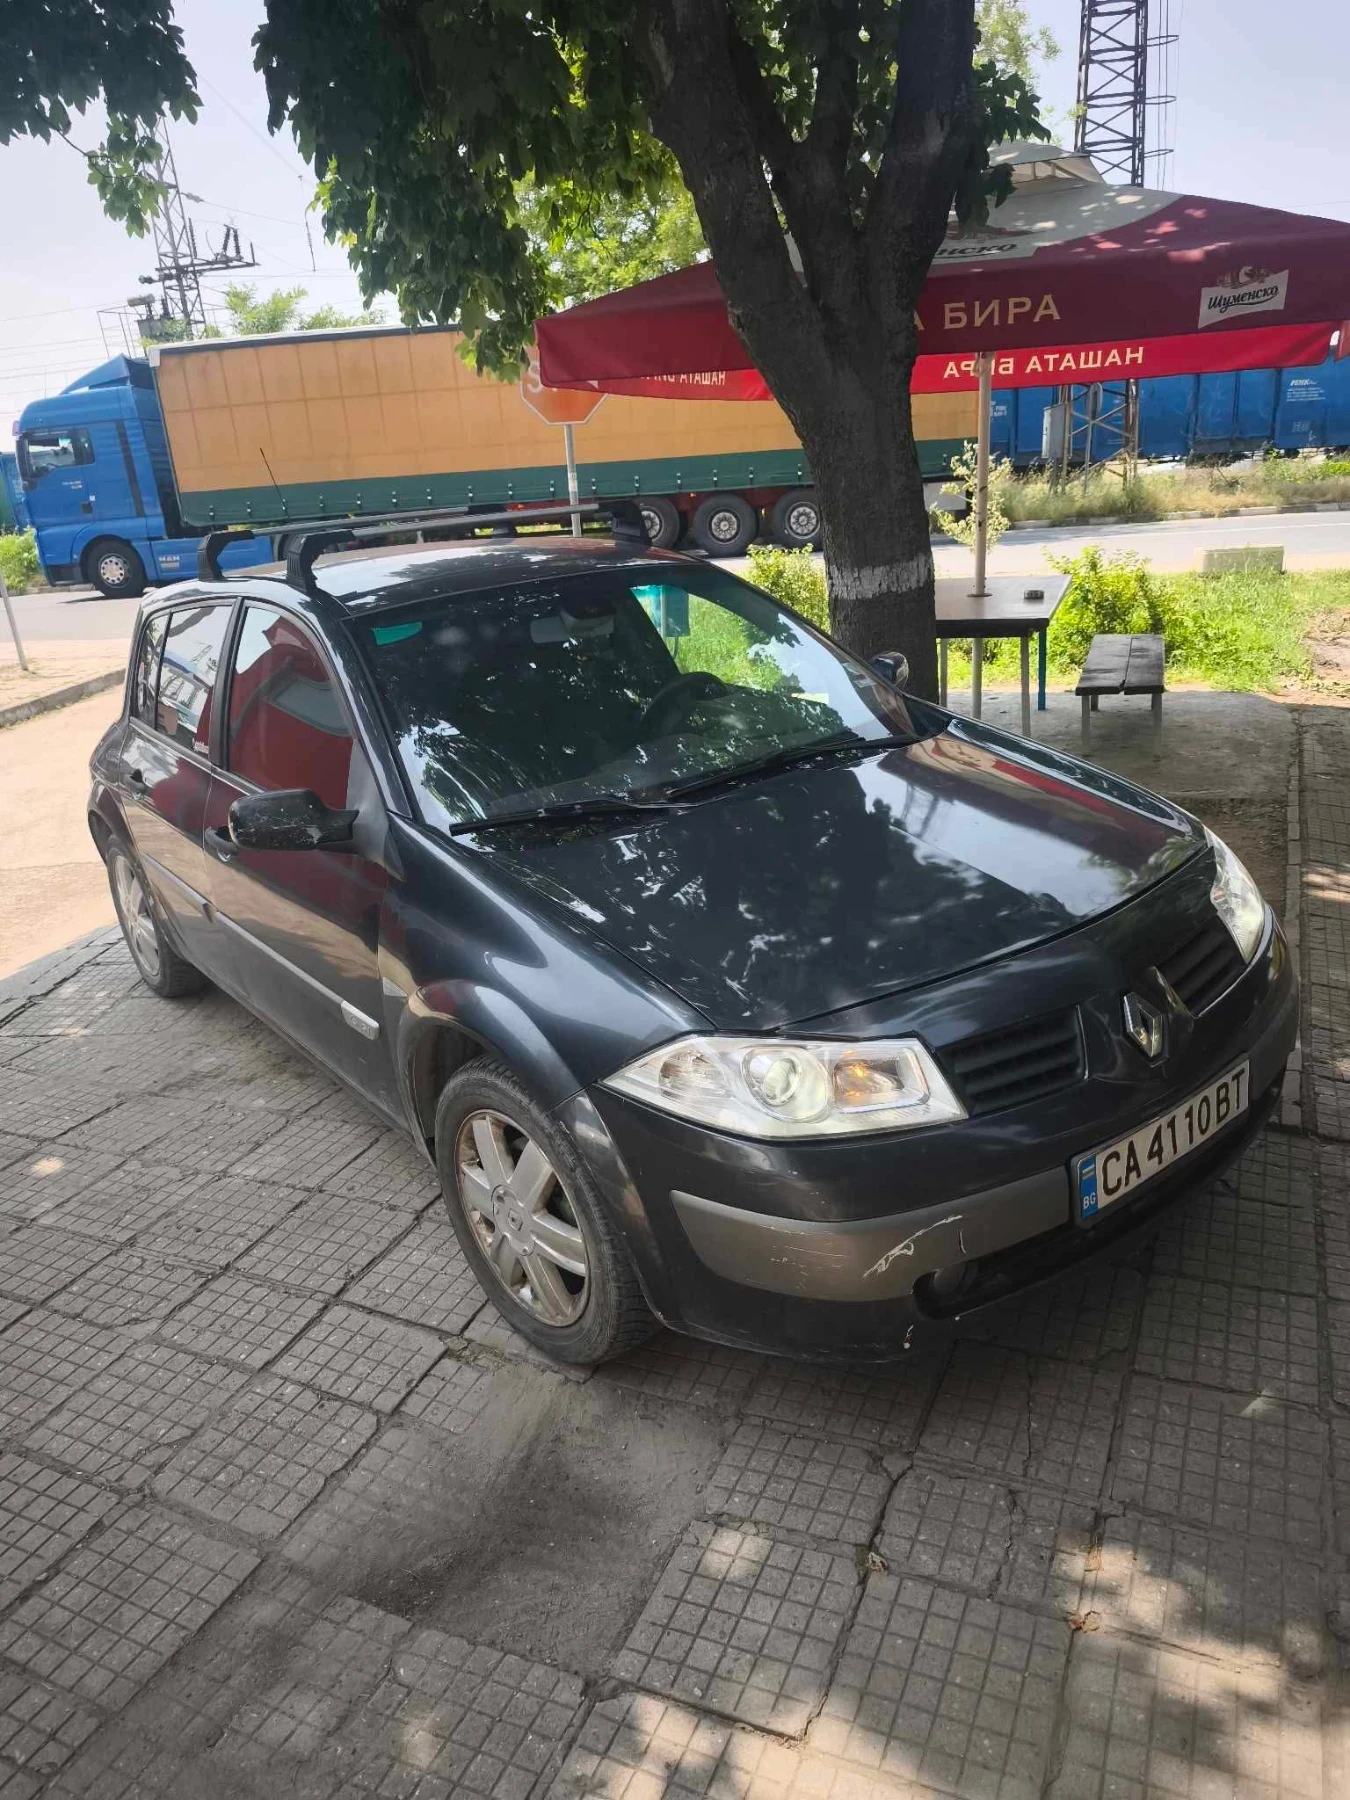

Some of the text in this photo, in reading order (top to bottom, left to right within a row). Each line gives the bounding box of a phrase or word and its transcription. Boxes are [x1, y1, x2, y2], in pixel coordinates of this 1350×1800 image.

[943, 294, 1062, 330] БИРА
[1207, 285, 1280, 314] Шуменско
[1083, 1192, 1097, 1209] BG
